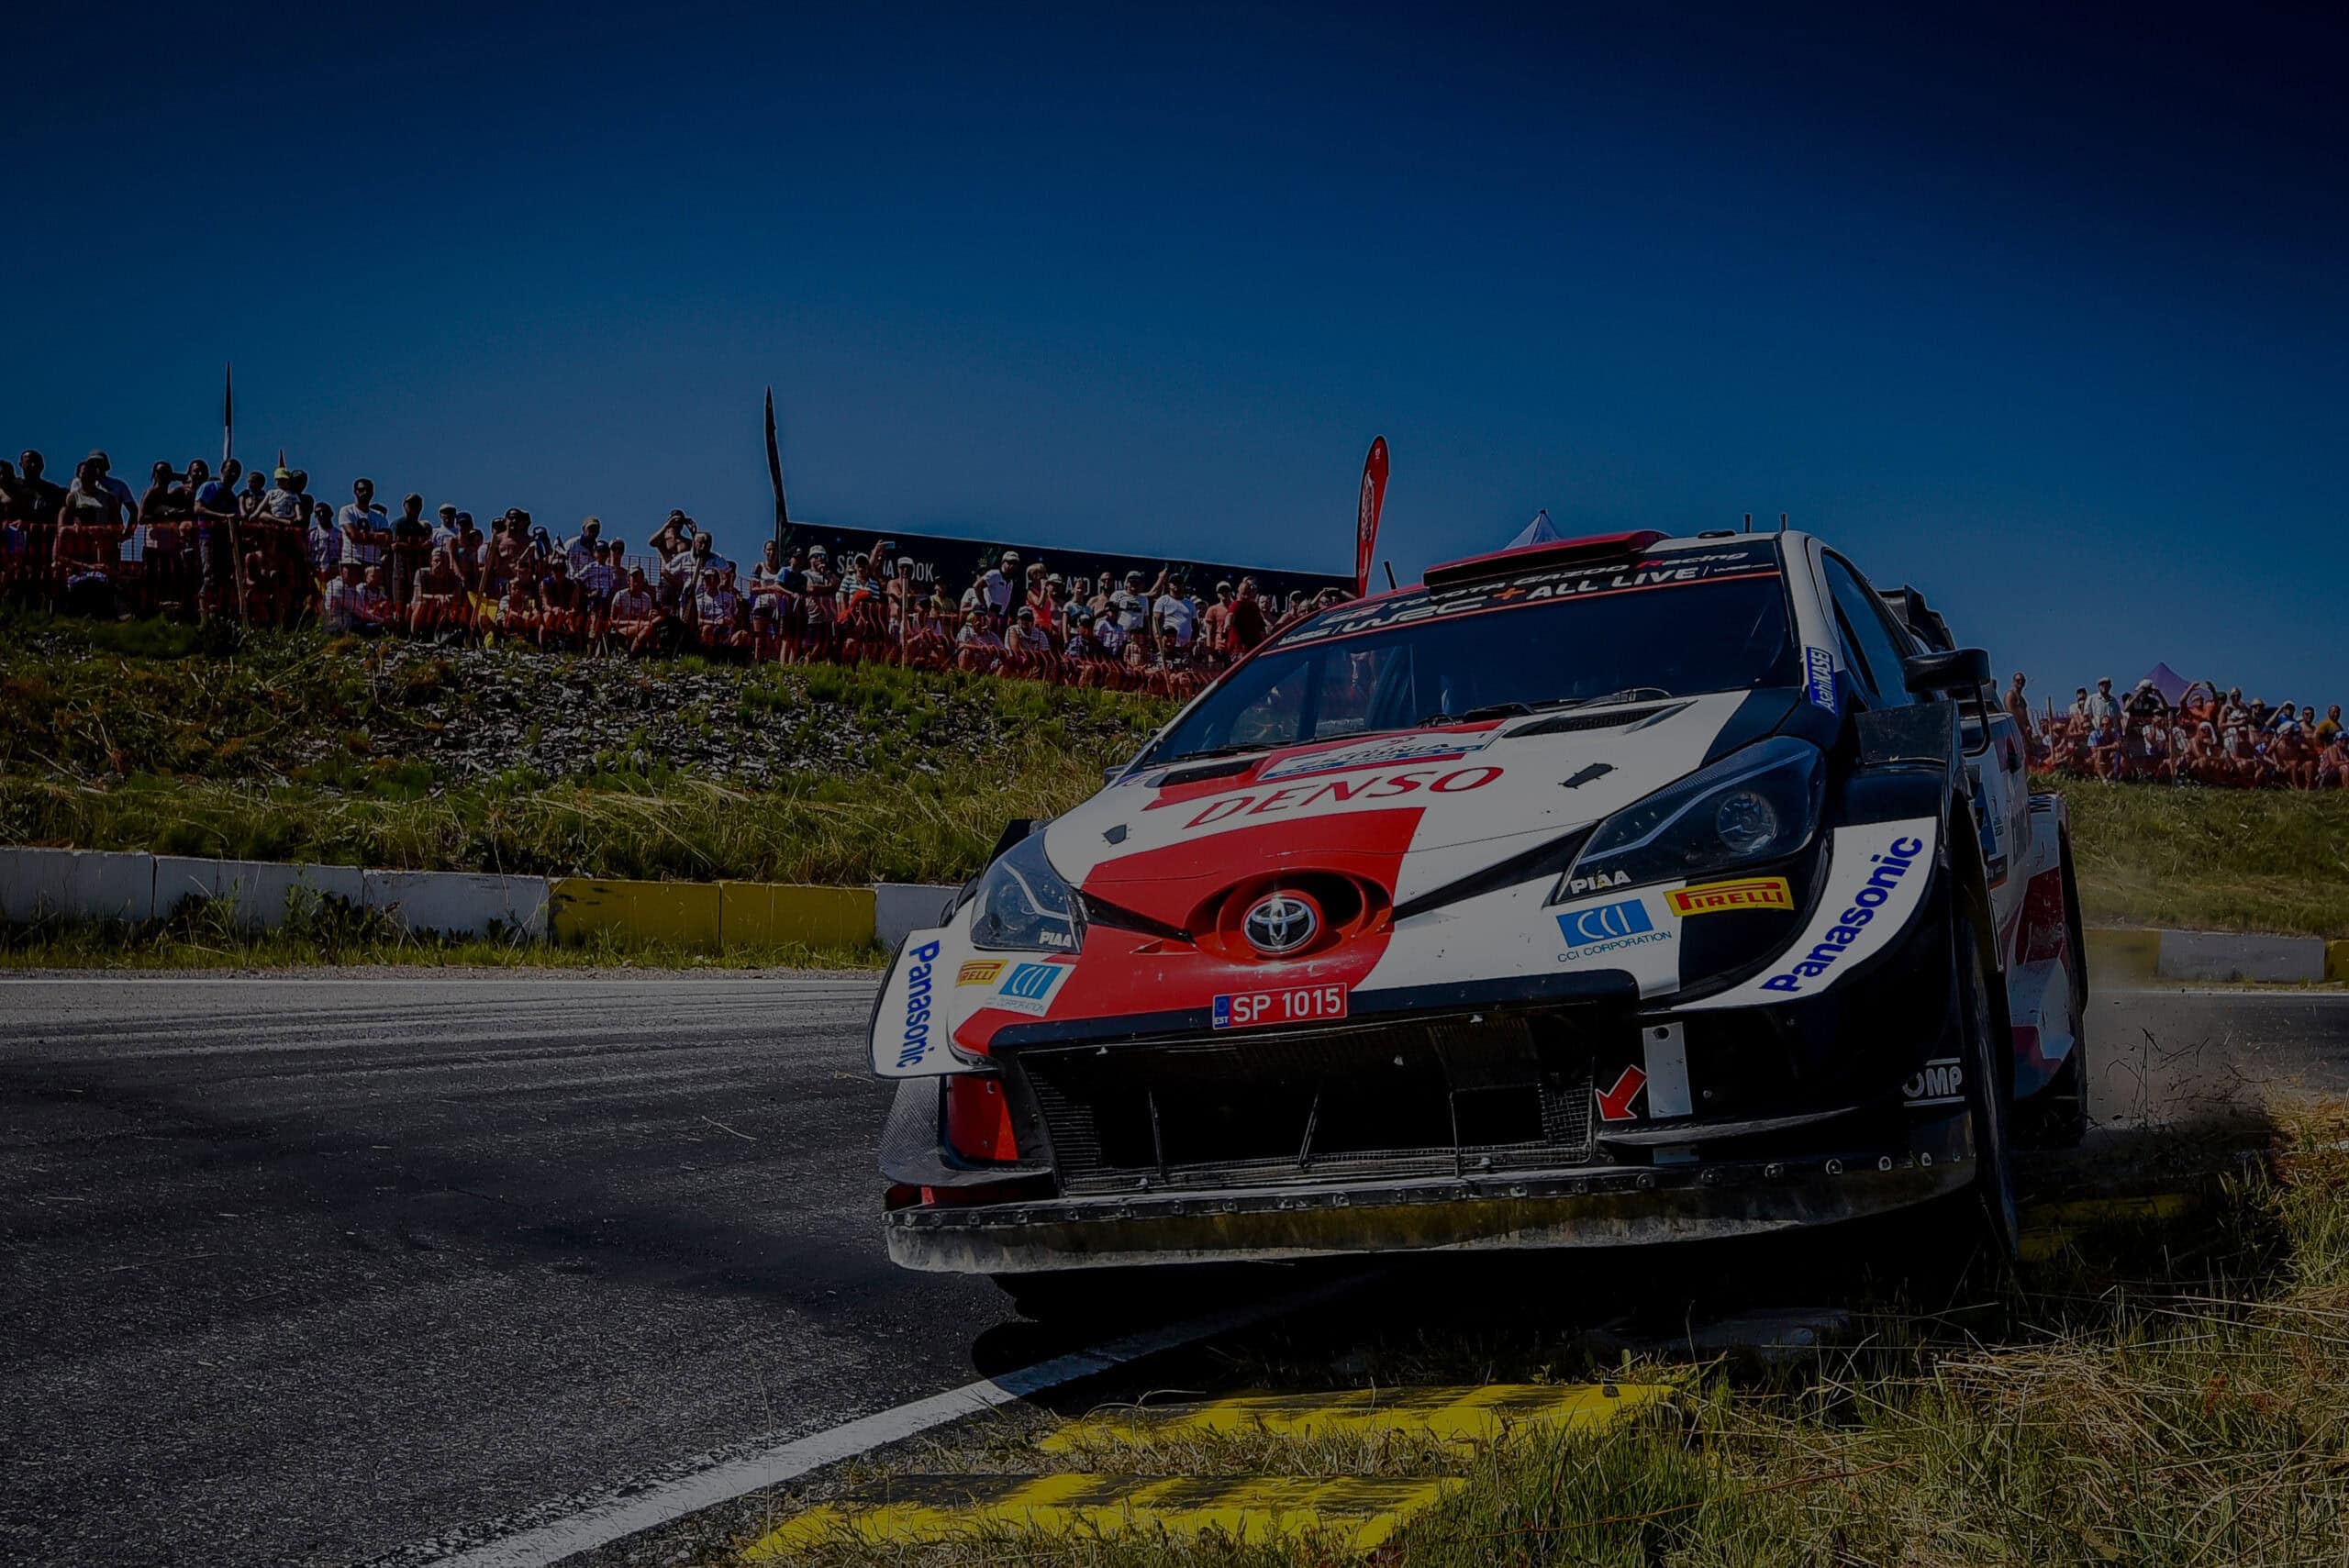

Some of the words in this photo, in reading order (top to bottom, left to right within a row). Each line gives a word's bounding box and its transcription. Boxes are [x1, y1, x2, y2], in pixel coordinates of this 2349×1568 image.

[1526, 579, 1599, 601] ALL
[1611, 566, 1699, 587] LIVE
[1182, 766, 1504, 829] DENSO
[1569, 869, 1632, 895] PIAA
[1675, 882, 1785, 911] PIRELLI
[1576, 905, 1631, 940] CCI
[1759, 836, 1923, 992] Panasonic
[1039, 930, 1072, 948] PIAA
[1557, 951, 1580, 963] CCI
[1584, 930, 1674, 957] CORPORATION
[896, 940, 941, 1068] Panasonic
[1232, 994, 1272, 1023] SP
[1281, 986, 1341, 1018] 1015
[1901, 1065, 1964, 1099] OMP
